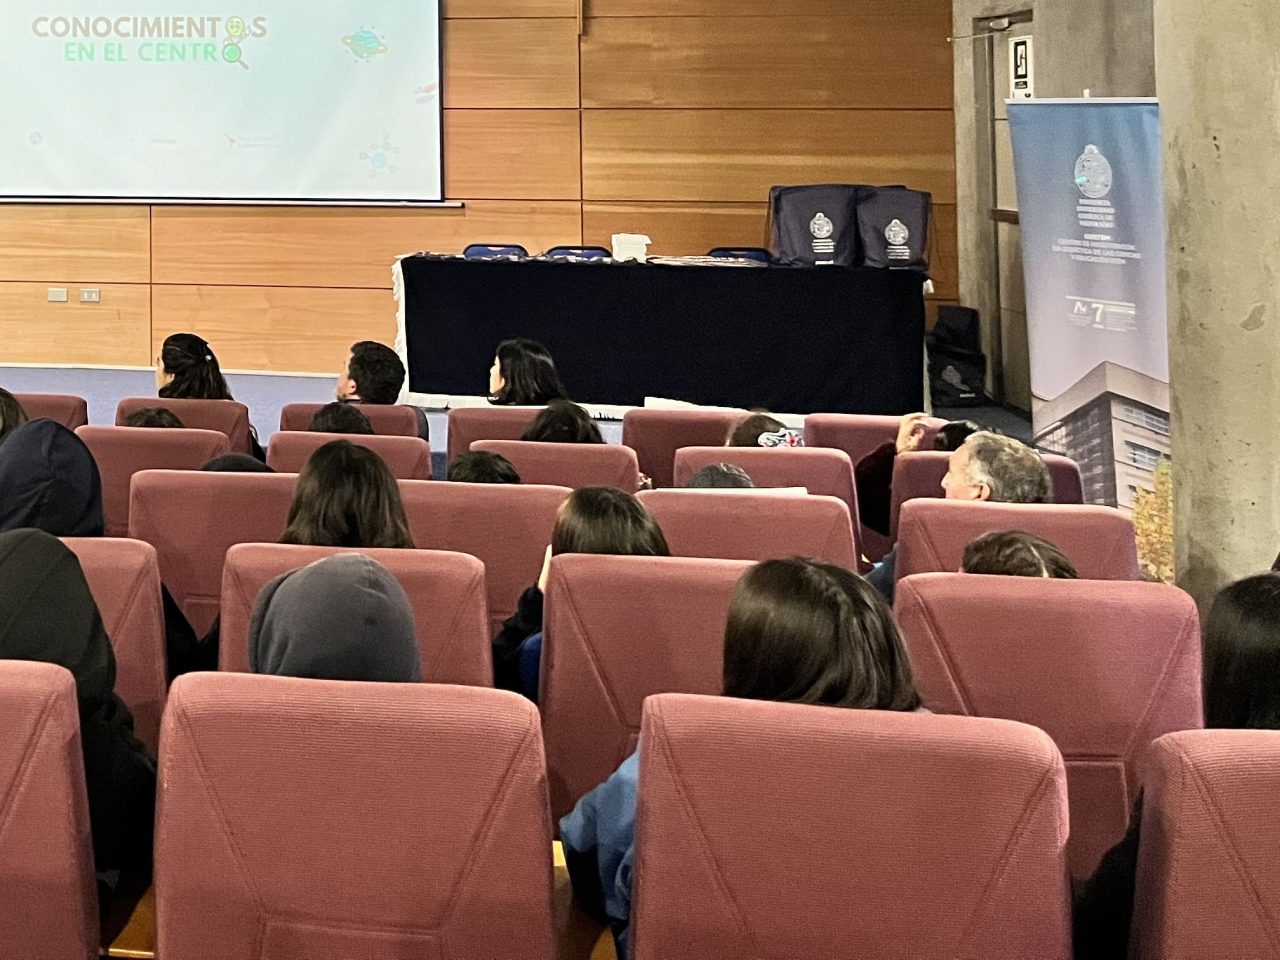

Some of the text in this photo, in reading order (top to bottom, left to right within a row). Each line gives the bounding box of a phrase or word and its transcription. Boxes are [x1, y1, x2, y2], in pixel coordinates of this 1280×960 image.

[64, 42, 243, 64] EN EL CENTRO
